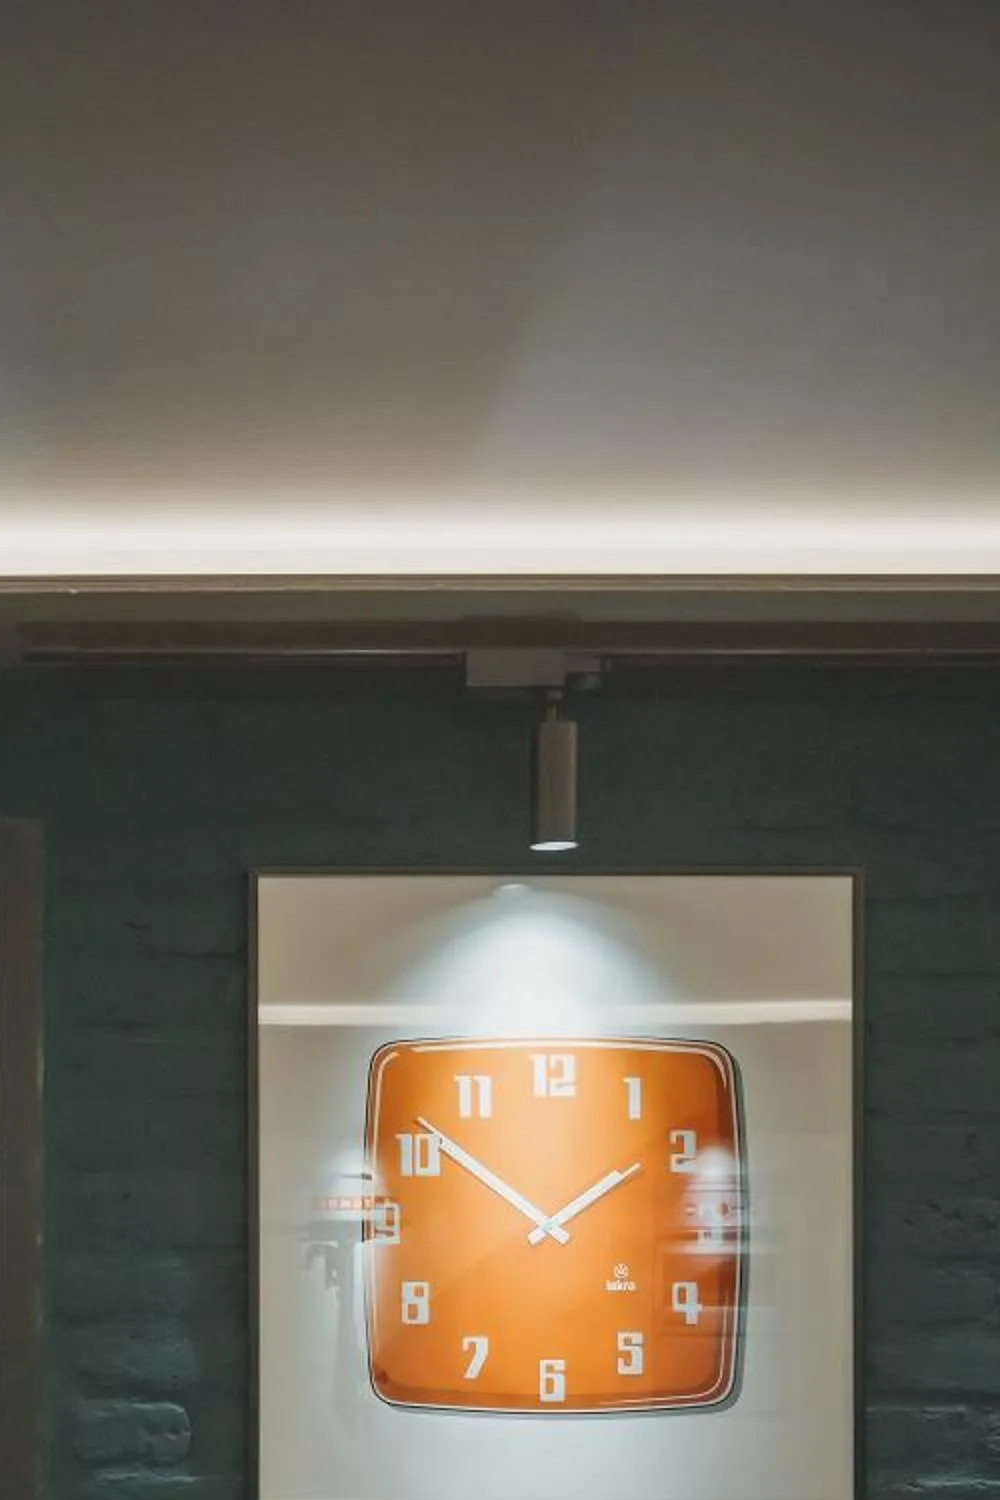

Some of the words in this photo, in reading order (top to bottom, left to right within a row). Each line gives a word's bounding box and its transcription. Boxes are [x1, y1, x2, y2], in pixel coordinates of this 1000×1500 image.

[454, 1074, 492, 1119] 11
[529, 1054, 576, 1097] 12
[623, 1077, 642, 1119] 1
[395, 1133, 441, 1177] 10
[669, 1129, 698, 1173] 2
[401, 1280, 430, 1325] 8
[671, 1281, 702, 1325] 4
[462, 1335, 489, 1380] 7
[617, 1331, 644, 1376] 5
[539, 1358, 566, 1403] 6
